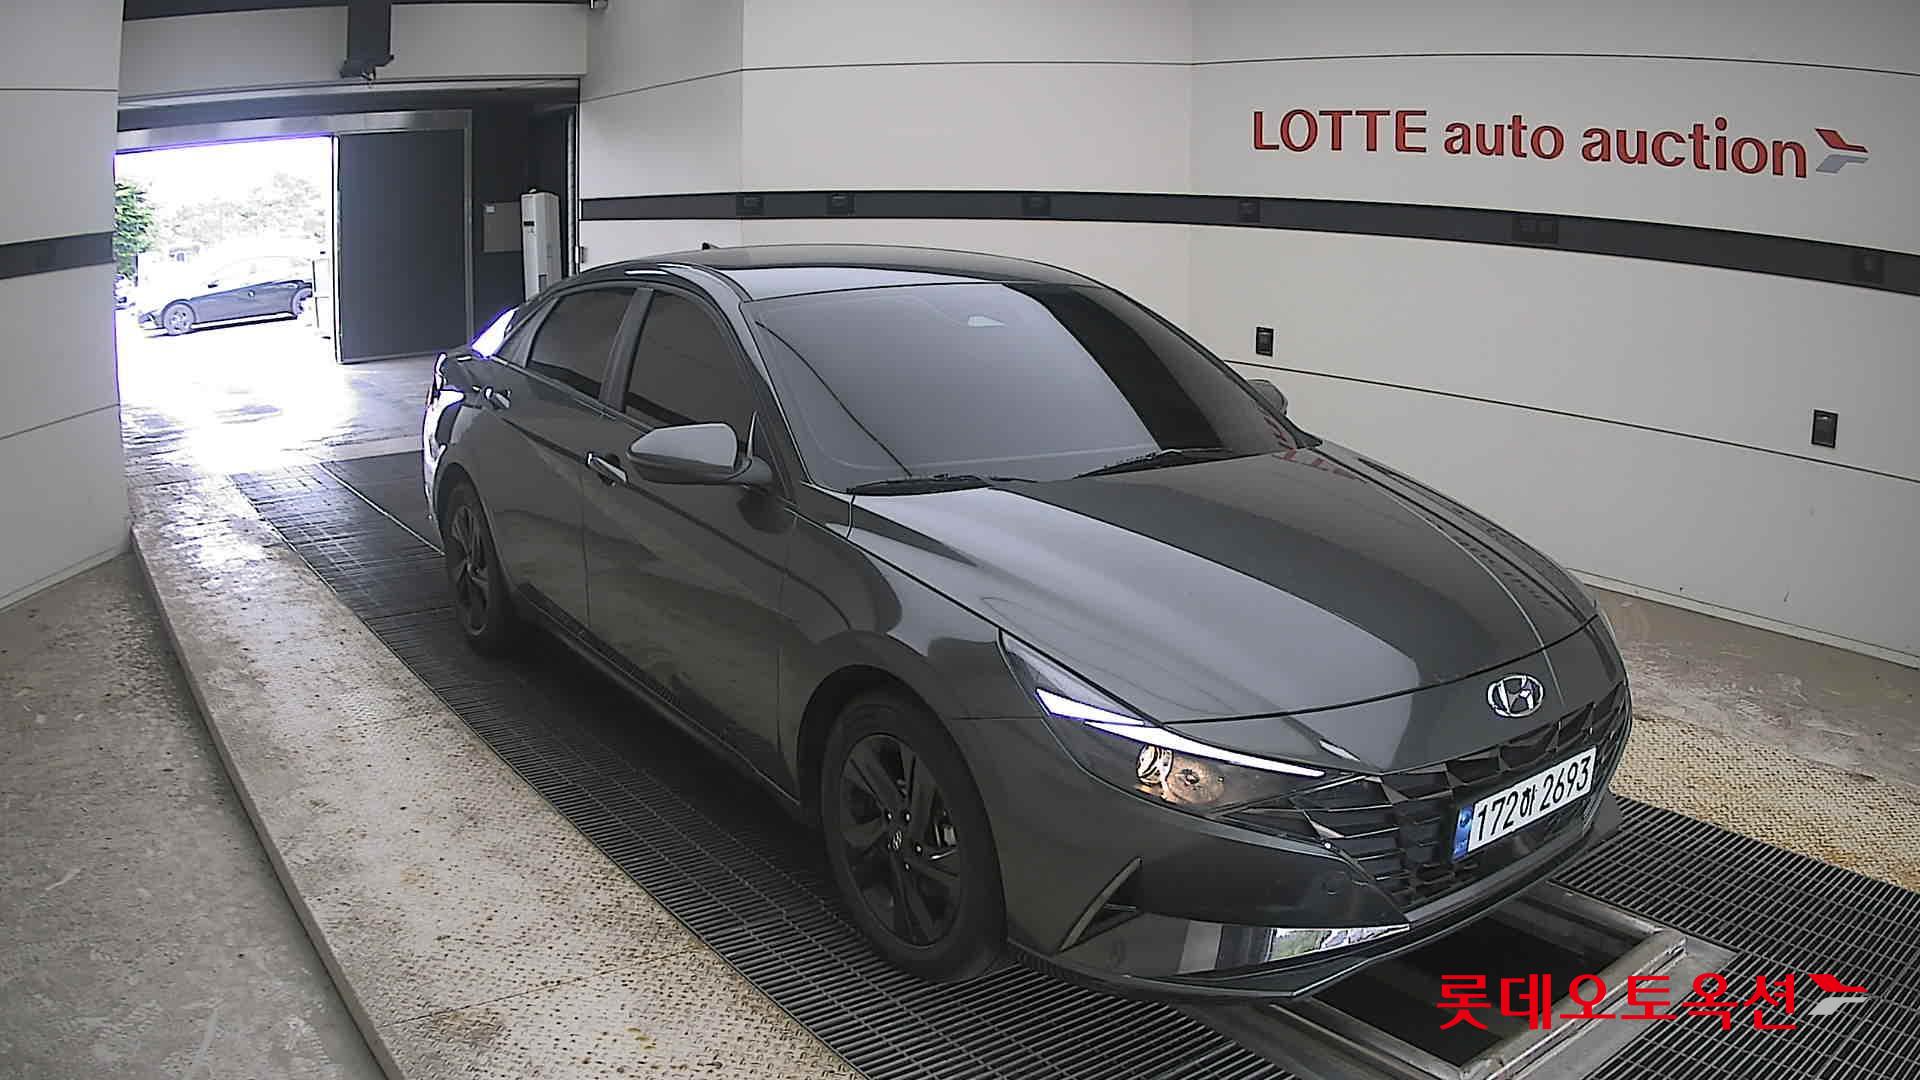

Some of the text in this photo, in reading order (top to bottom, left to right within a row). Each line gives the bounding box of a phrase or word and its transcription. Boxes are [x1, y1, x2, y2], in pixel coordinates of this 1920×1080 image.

[1253, 109, 1808, 178] LOTTE auto auction
[1540, 755, 1592, 812] 2693
